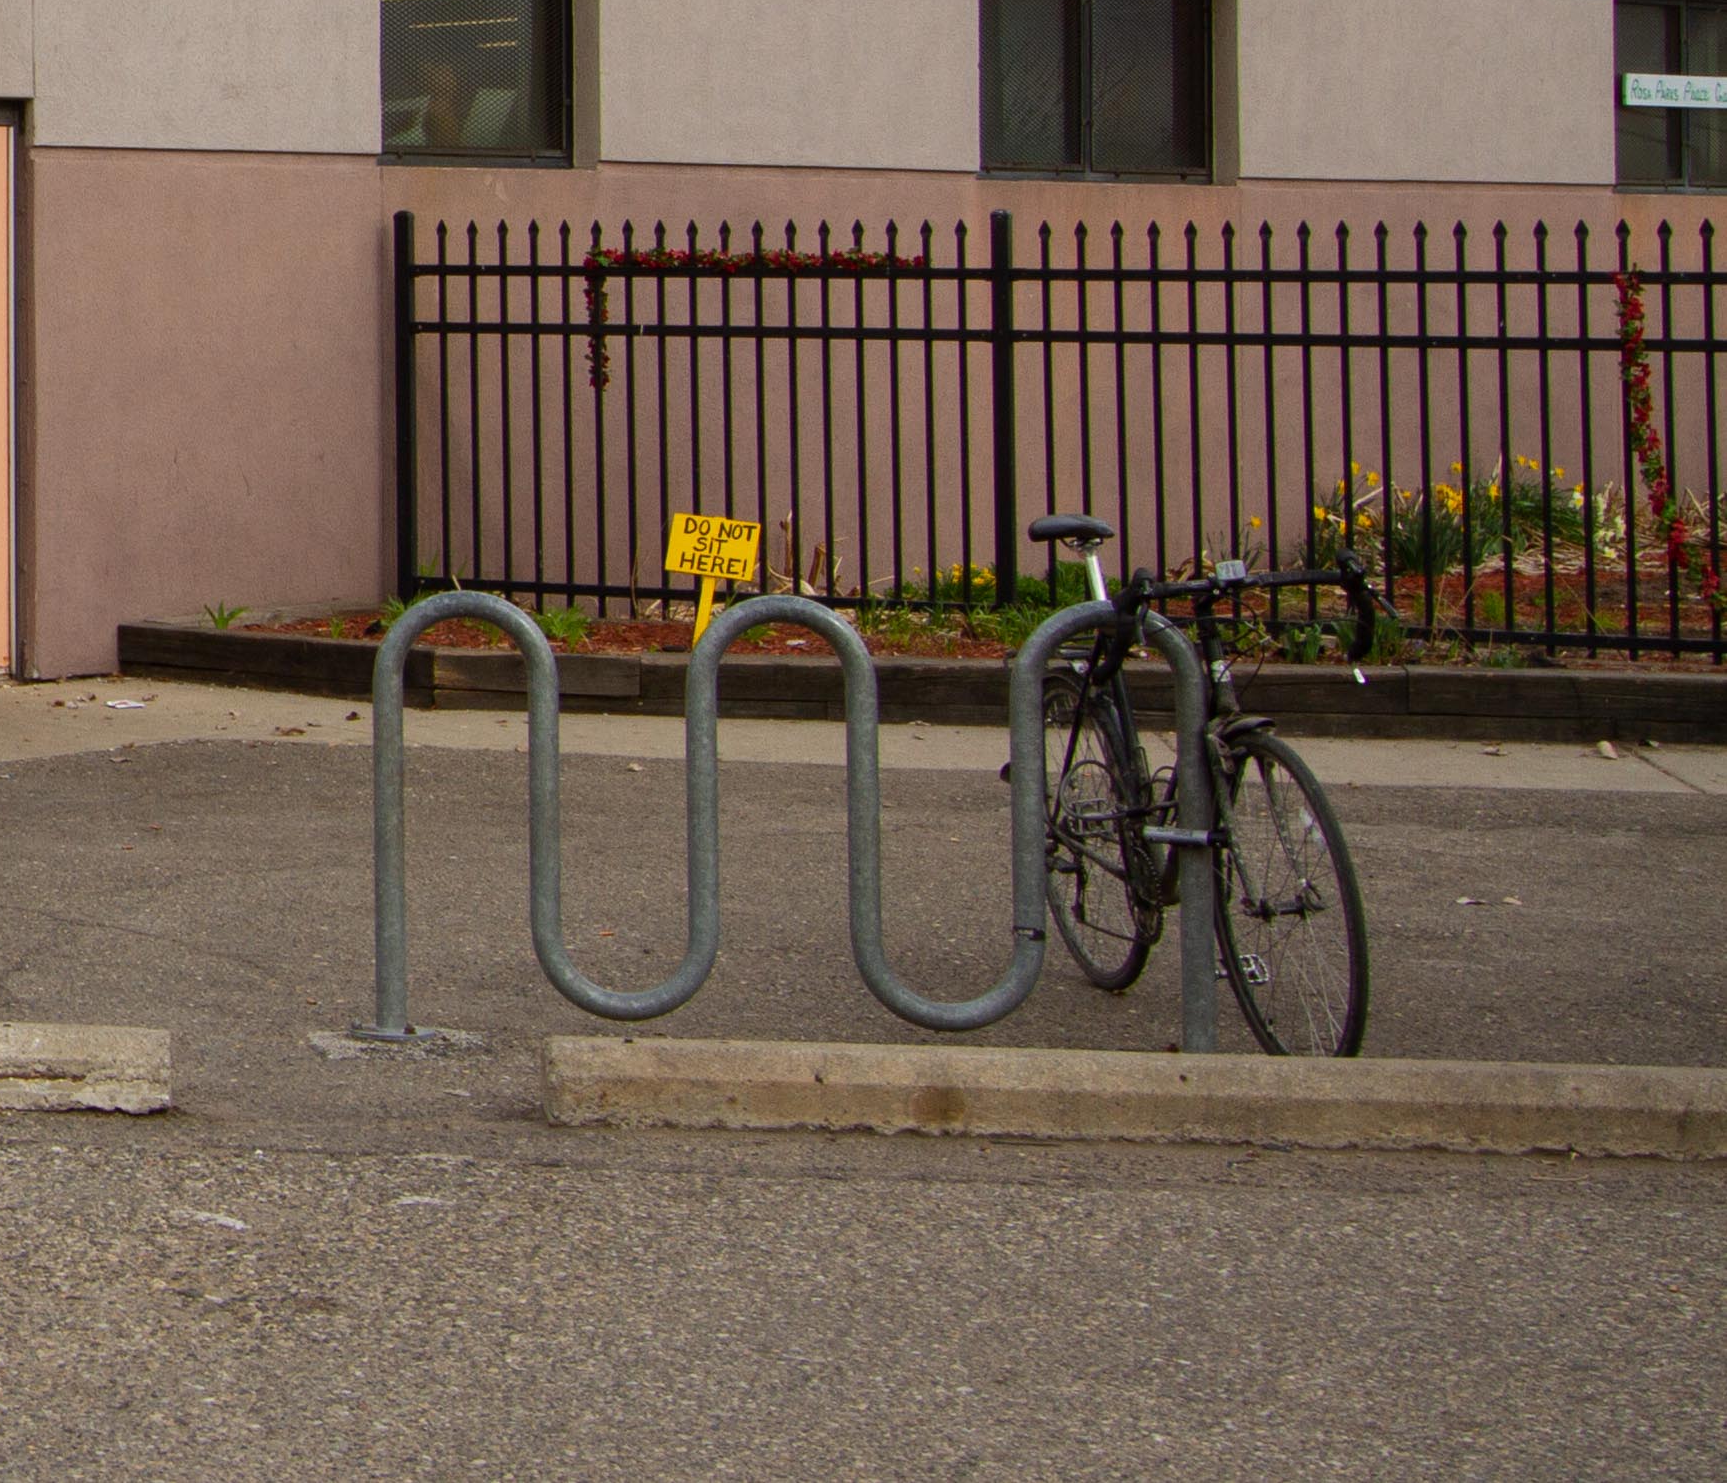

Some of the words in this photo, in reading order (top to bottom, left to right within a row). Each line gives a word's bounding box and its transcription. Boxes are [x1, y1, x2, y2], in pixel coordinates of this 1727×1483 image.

[684, 517, 711, 536] DO
[718, 522, 757, 542] NOT
[679, 552, 747, 577] HERE!
